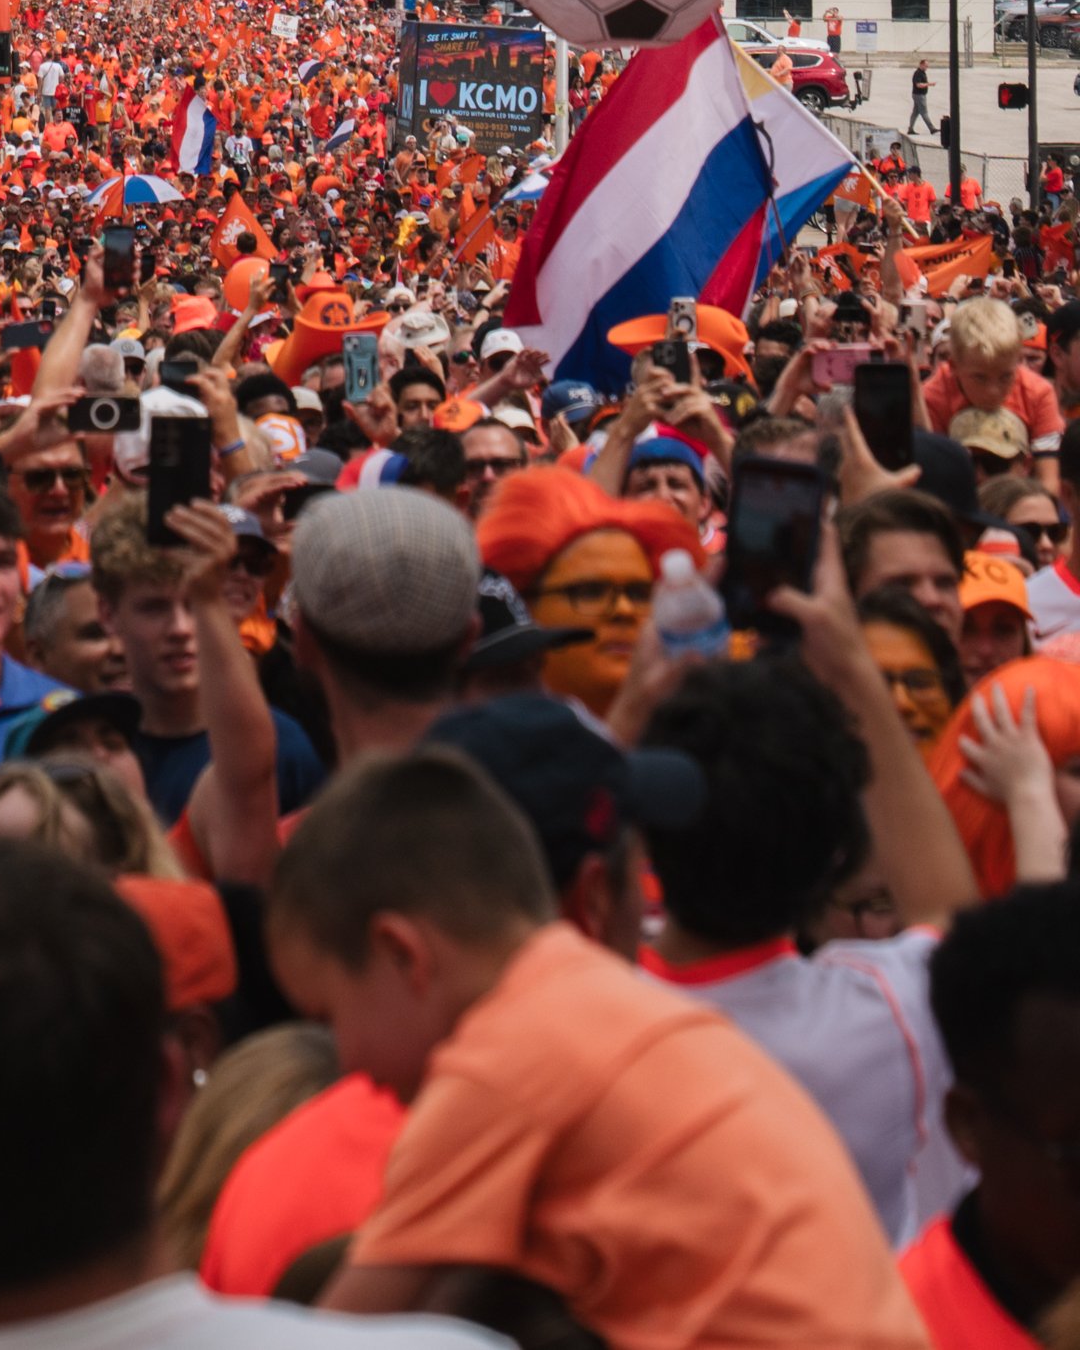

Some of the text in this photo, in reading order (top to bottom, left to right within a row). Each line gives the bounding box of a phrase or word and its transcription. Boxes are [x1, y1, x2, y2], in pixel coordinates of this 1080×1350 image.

[427, 33, 439, 42] SEE
[451, 32, 468, 41] SNAP
[433, 42, 463, 52] SHARE
[419, 79, 428, 106] I
[459, 81, 538, 113] KCMO
